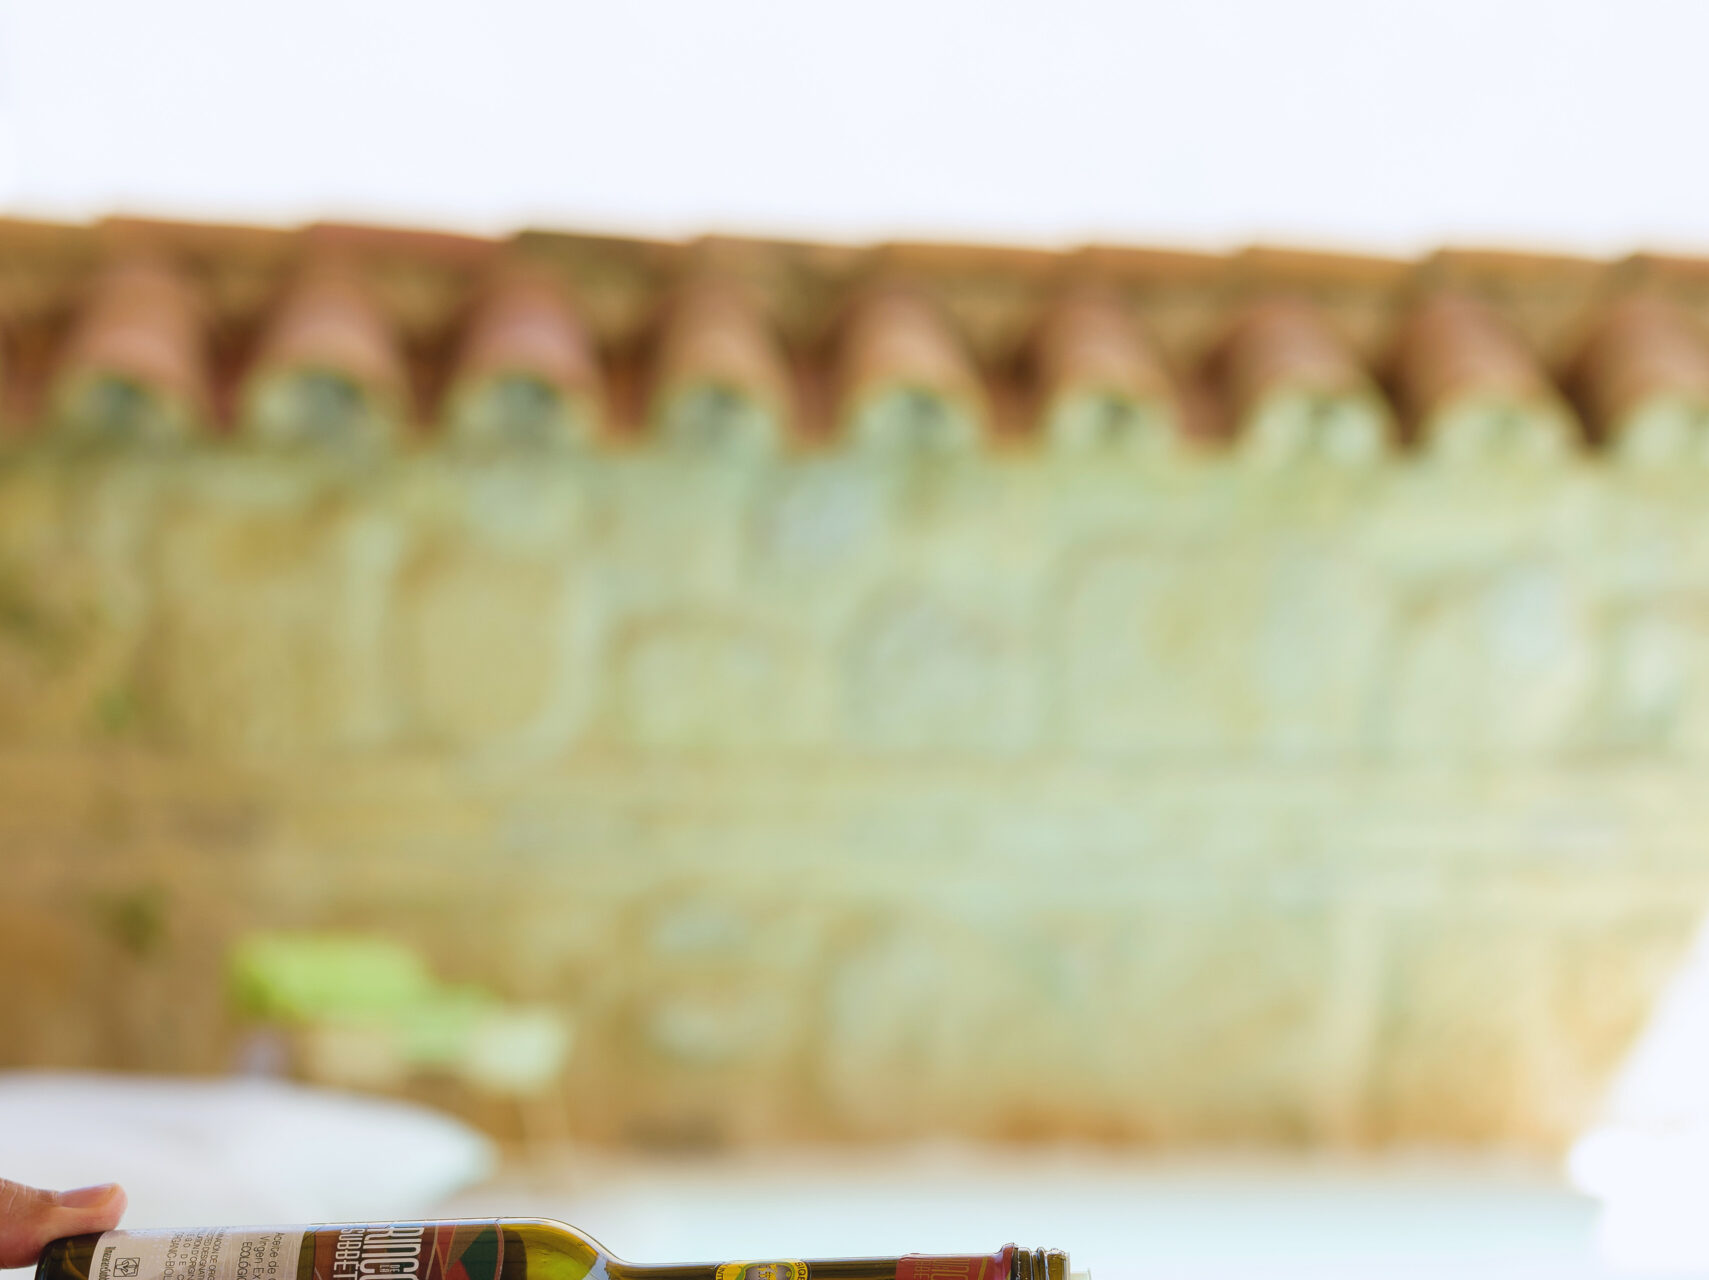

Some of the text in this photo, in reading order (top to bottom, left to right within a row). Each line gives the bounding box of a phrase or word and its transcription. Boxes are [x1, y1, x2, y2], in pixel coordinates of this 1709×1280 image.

[253, 1236, 270, 1264] Virgen
[269, 1233, 285, 1258] Aceite
[179, 1254, 188, 1266] DE
[210, 1255, 218, 1263] DE
[268, 1261, 279, 1274] de
